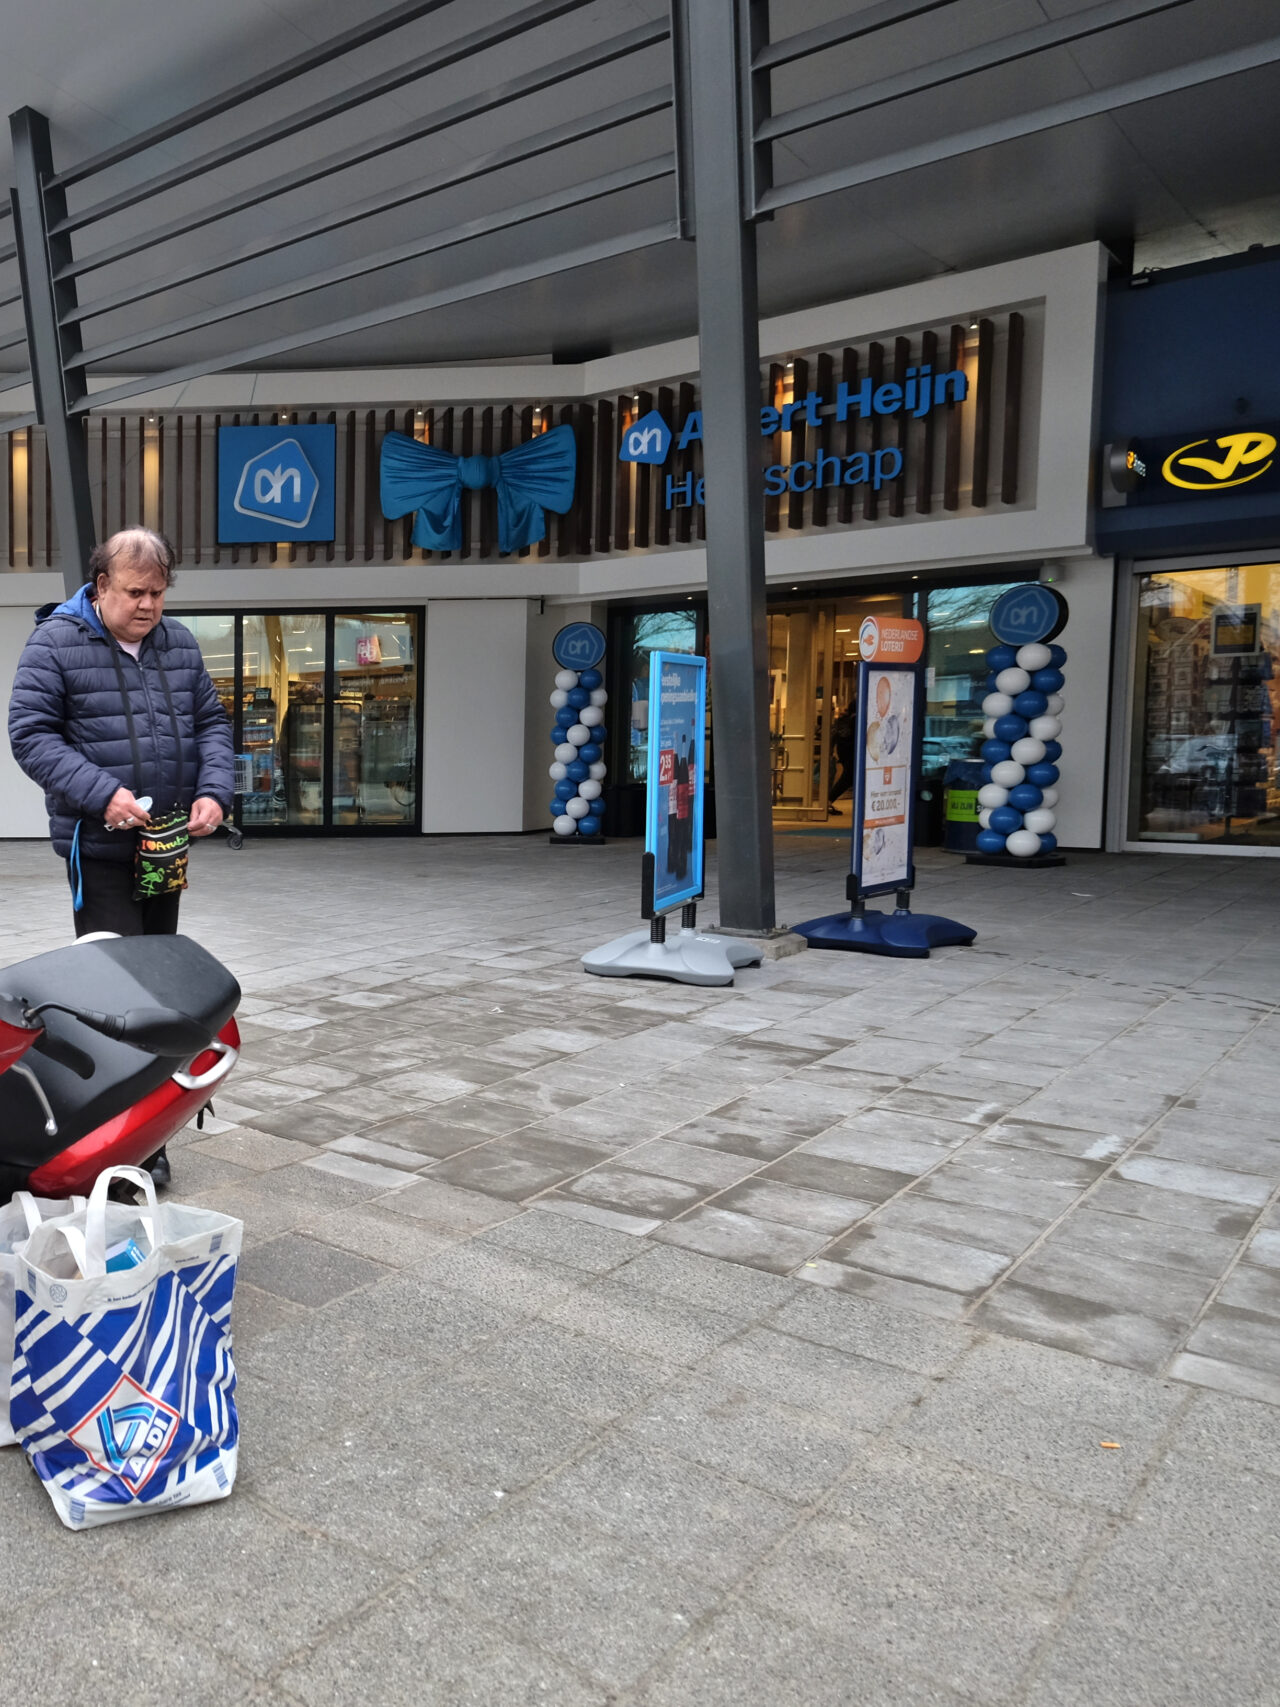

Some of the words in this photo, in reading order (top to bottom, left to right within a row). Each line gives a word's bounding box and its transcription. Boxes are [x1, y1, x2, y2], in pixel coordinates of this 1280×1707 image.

[677, 391, 823, 450] Aert
[835, 364, 969, 422] Heijn
[128, 1416, 169, 1478] ALDI
